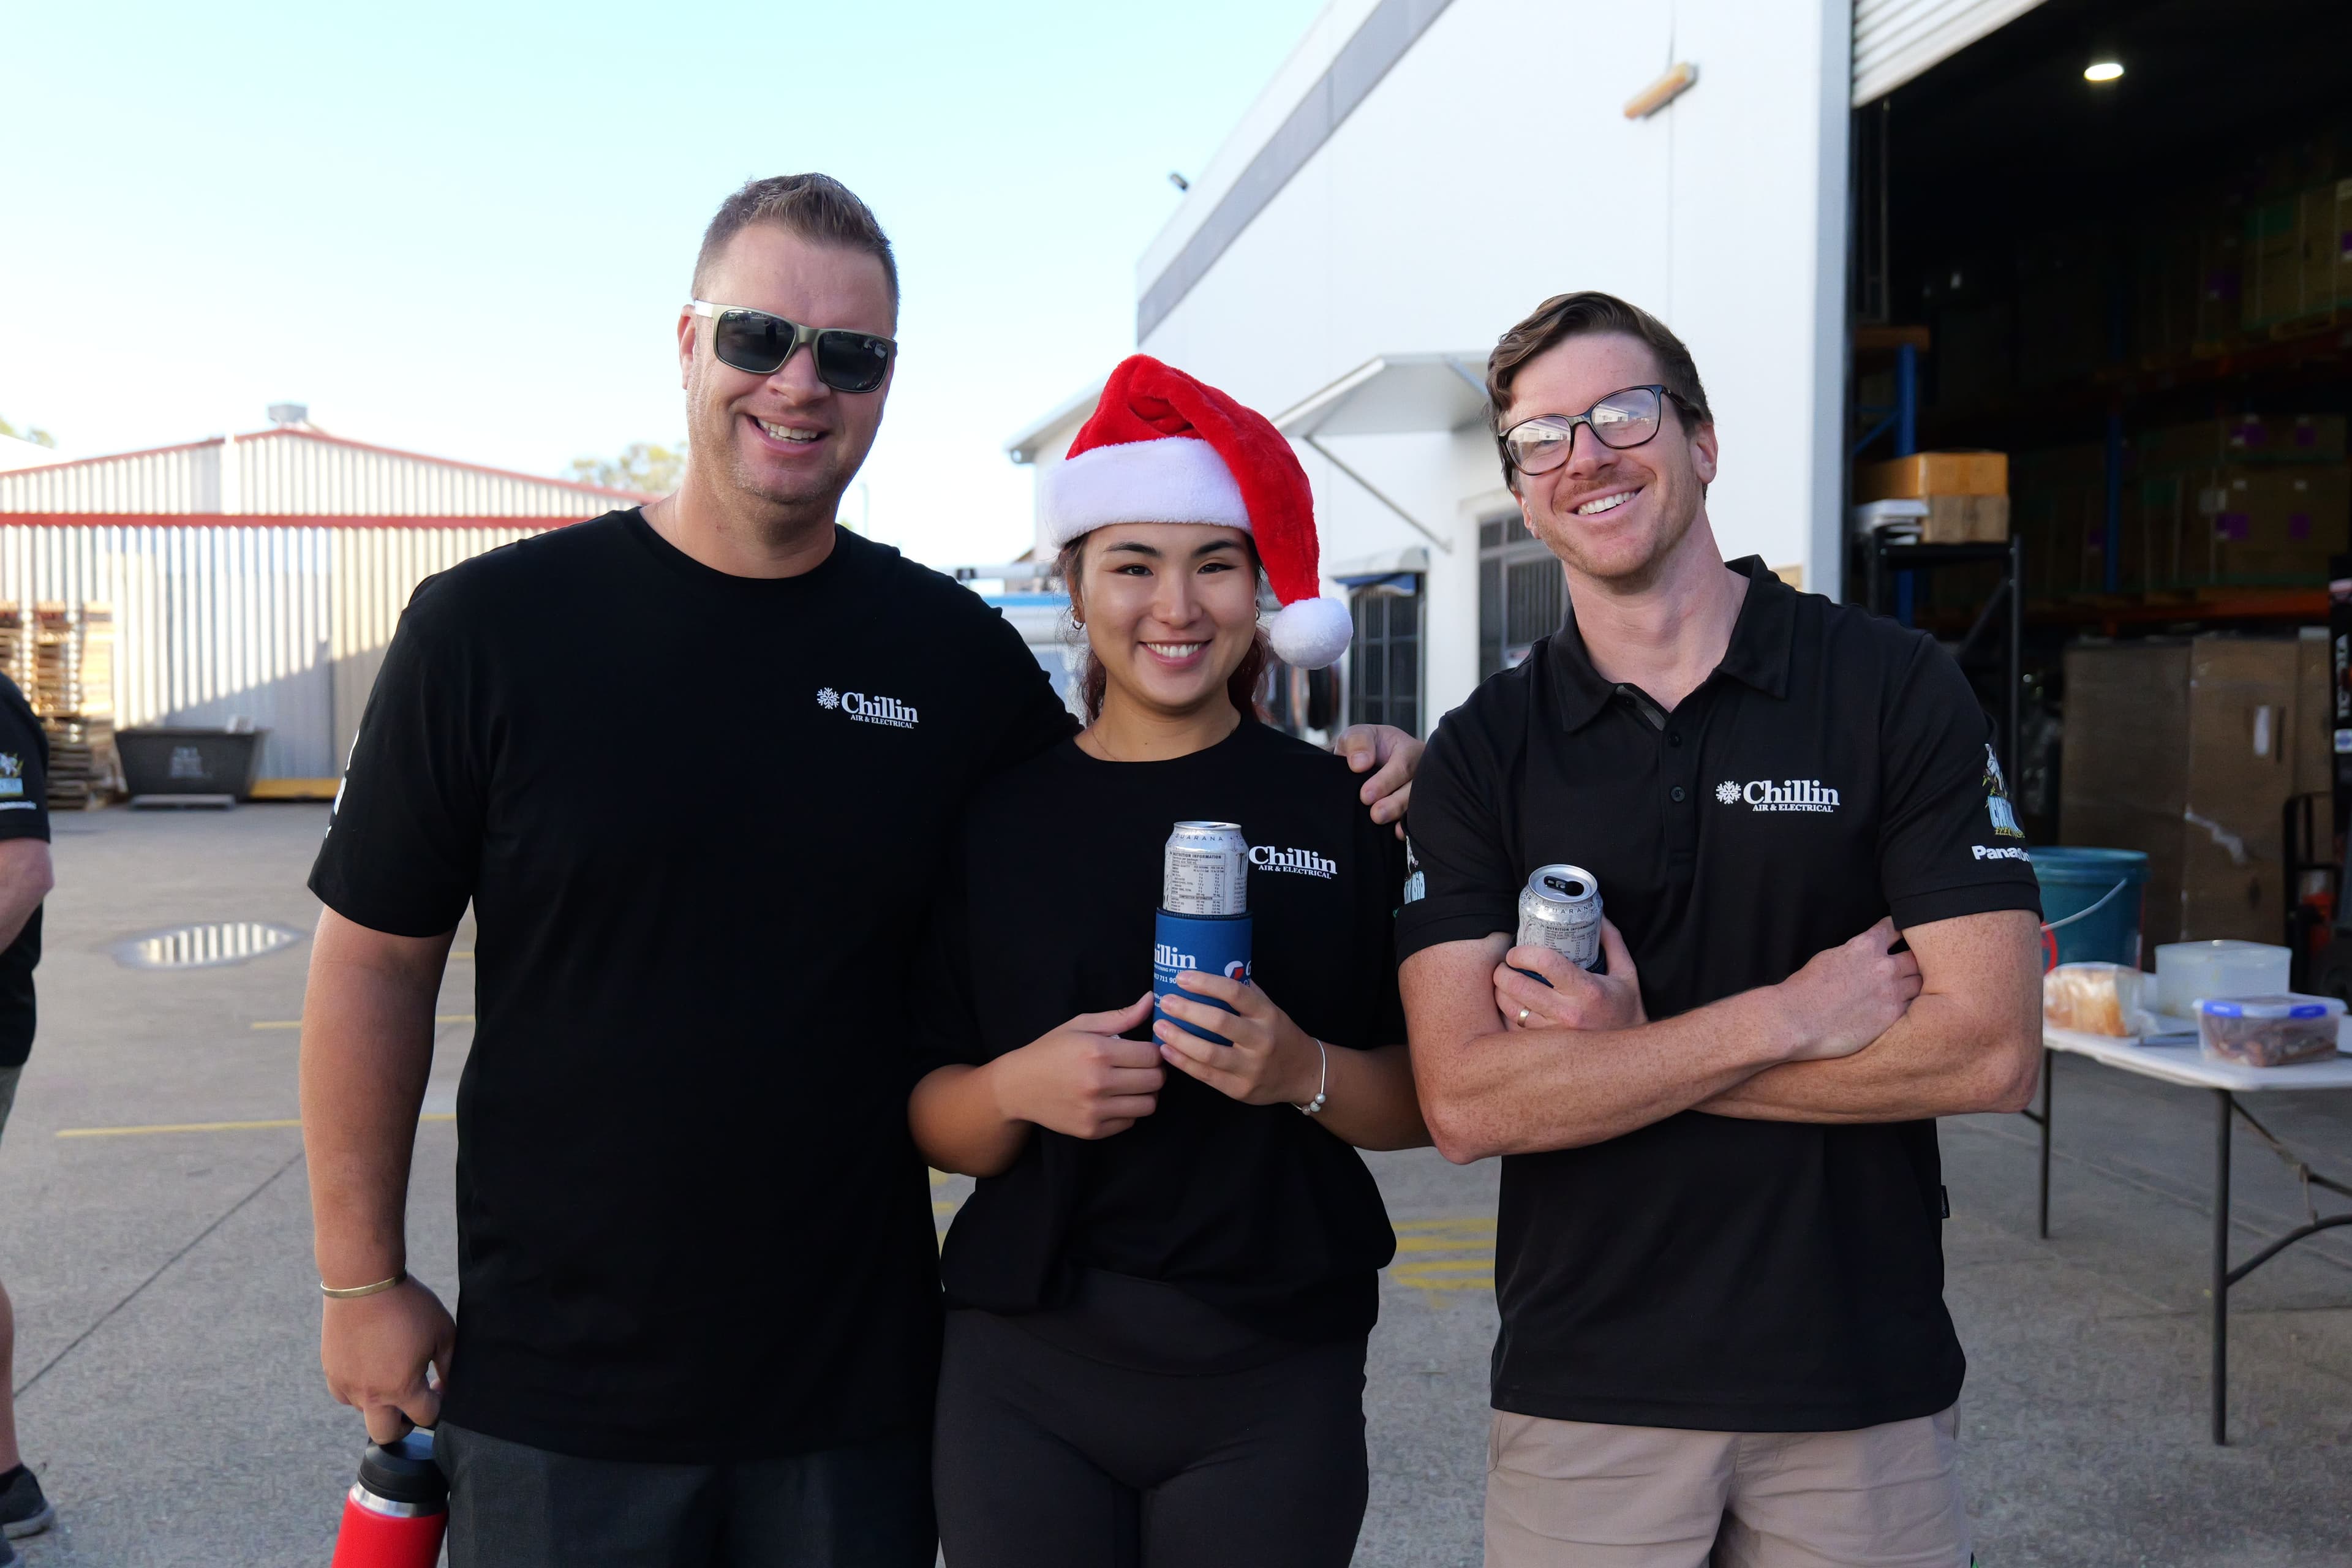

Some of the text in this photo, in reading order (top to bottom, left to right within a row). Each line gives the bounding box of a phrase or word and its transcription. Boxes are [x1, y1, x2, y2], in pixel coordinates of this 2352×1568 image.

[841, 692, 919, 723] Chillin
[871, 717, 914, 729] ELECTRICAL
[1743, 780, 1840, 806] Chillin
[1778, 804, 1834, 813] ELECTRICAL
[1248, 845, 1338, 875] Chillin
[1971, 845, 2030, 862] Panason
[1283, 865, 1332, 880] ELECTRICAL
[1544, 902, 1594, 914] GUARANA
